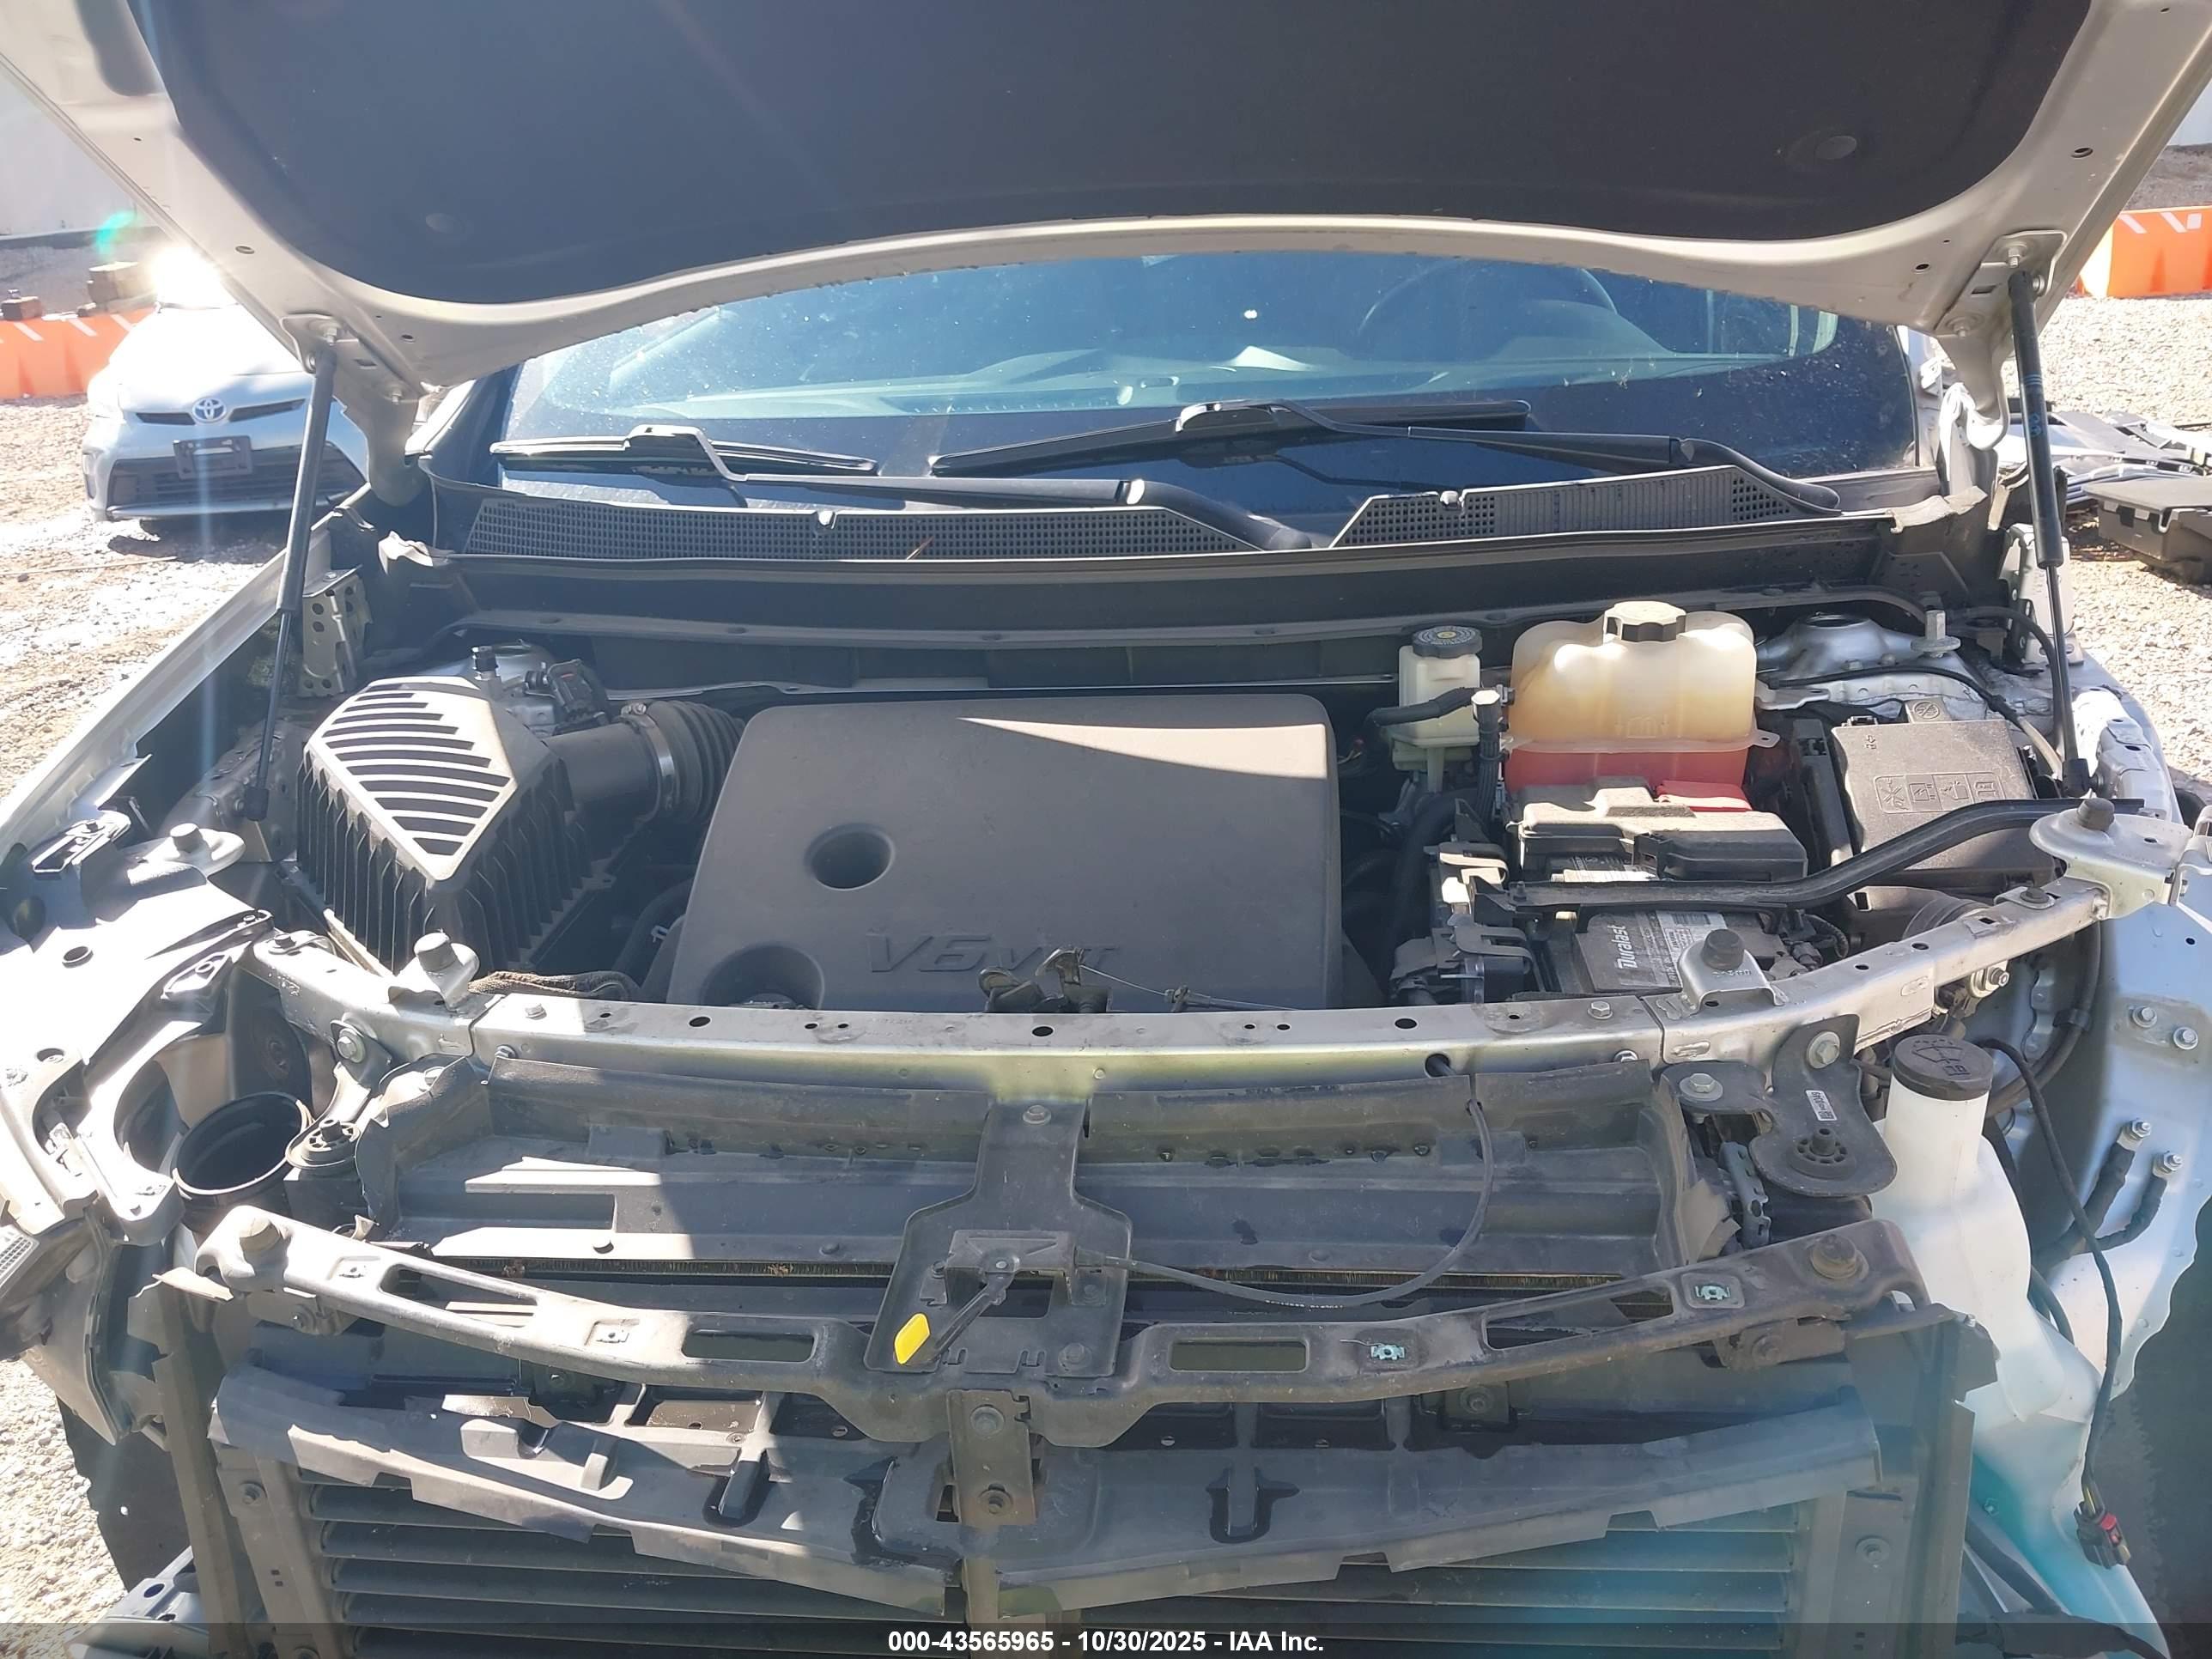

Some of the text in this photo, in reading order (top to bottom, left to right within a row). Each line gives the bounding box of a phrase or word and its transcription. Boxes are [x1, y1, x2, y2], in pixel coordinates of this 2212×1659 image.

[866, 932, 1120, 973] V6 VT
[1607, 924, 1638, 969] Duralast
